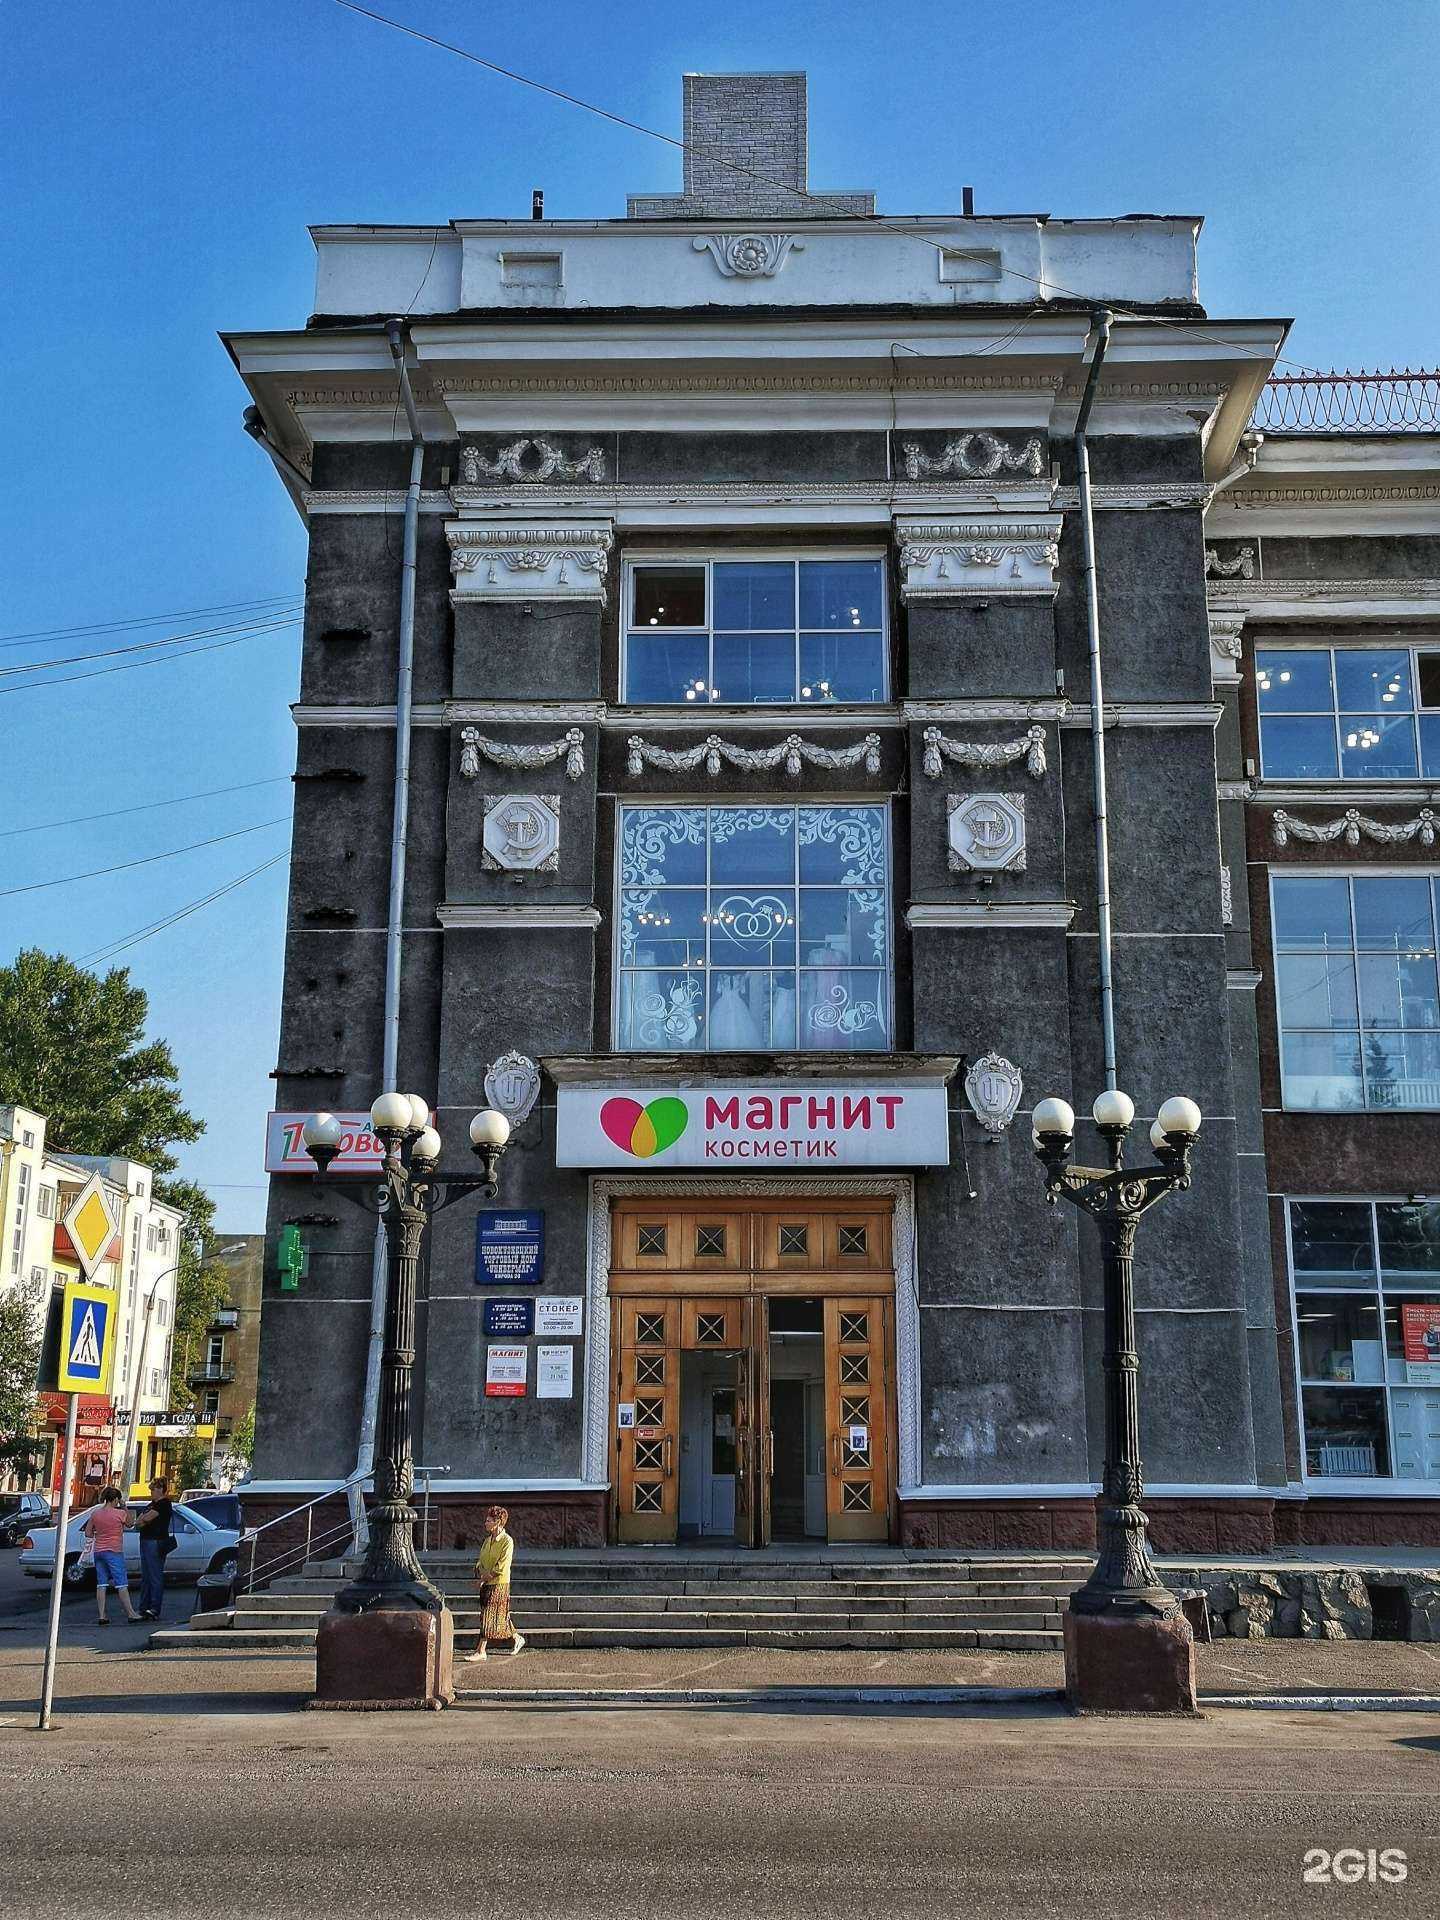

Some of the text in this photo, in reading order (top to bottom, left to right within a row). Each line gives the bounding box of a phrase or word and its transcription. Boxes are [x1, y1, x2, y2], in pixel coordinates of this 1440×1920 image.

[704, 1139, 838, 1158] косметик
[481, 1245, 539, 1255] НОВОКУЗНЕЦКИЙ
[484, 1255, 536, 1264] ТОРГОВЫЙ ДОМ
[491, 1349, 524, 1357] МАГНИТ
[160, 1414, 167, 1424] 2
[172, 1413, 197, 1425] ГОДА
